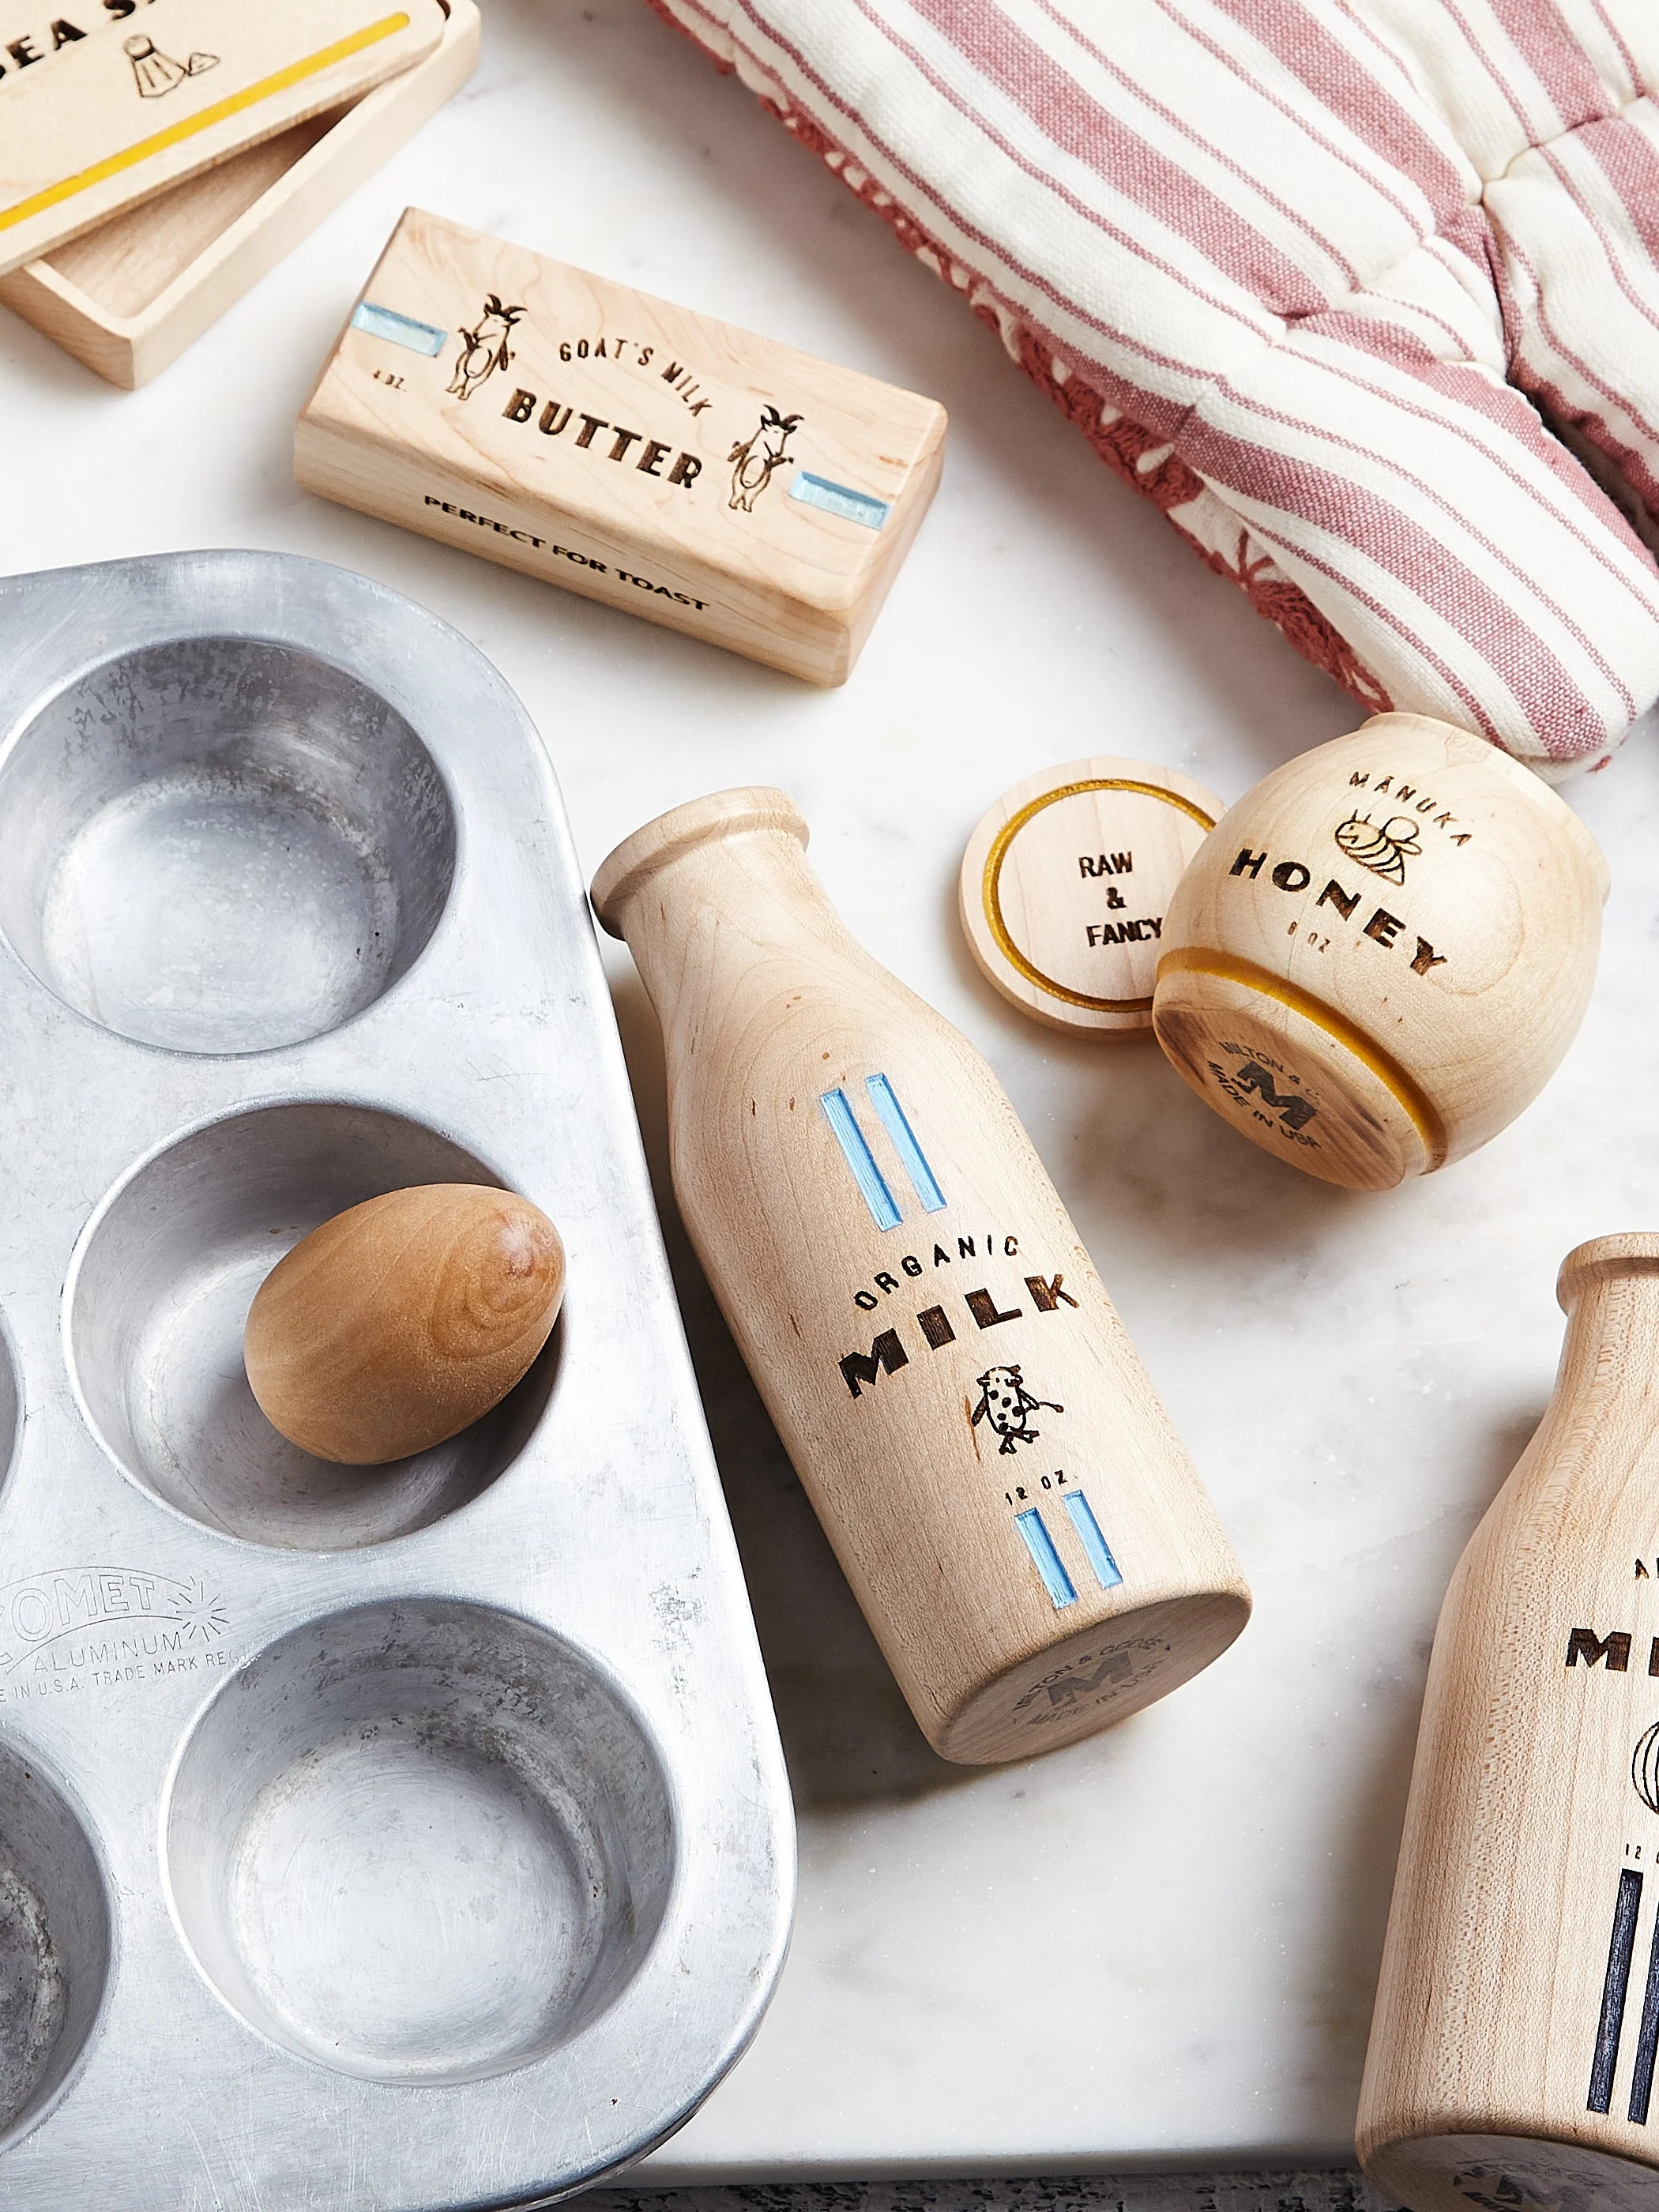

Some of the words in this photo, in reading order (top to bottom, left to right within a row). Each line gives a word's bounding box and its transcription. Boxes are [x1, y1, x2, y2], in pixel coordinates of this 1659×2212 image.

[0, 17, 88, 79] EA
[559, 337, 655, 367] GOAT'S
[660, 361, 713, 417] MILK
[502, 387, 702, 489] BUTTER
[424, 495, 546, 548] PERFECT
[551, 544, 608, 574] FOR
[615, 568, 710, 611] TOAST
[1078, 851, 1133, 878] RAW
[1107, 886, 1127, 909] &
[1228, 848, 1448, 977] HONEY
[1086, 917, 1163, 947] FANCY
[1207, 1060, 1251, 1107] MADE
[1253, 1110, 1273, 1128] IN
[1279, 1125, 1322, 1149] USA
[1288, 1074, 1301, 1085] &
[854, 1235, 1018, 1311] ORGANIC
[838, 1274, 1080, 1399] MILK
[1006, 1487, 1028, 1506] 12
[1635, 1558, 1659, 1580] A
[0, 1574, 155, 1665] OMET
[15, 1684, 30, 1700] IN
[38, 1677, 85, 1695] U.S.A.
[92, 1665, 145, 1686] TRADE
[153, 1656, 198, 1676] MARK
[33, 1631, 182, 1675] ALUMINUM
[1626, 1843, 1641, 1860] 12
